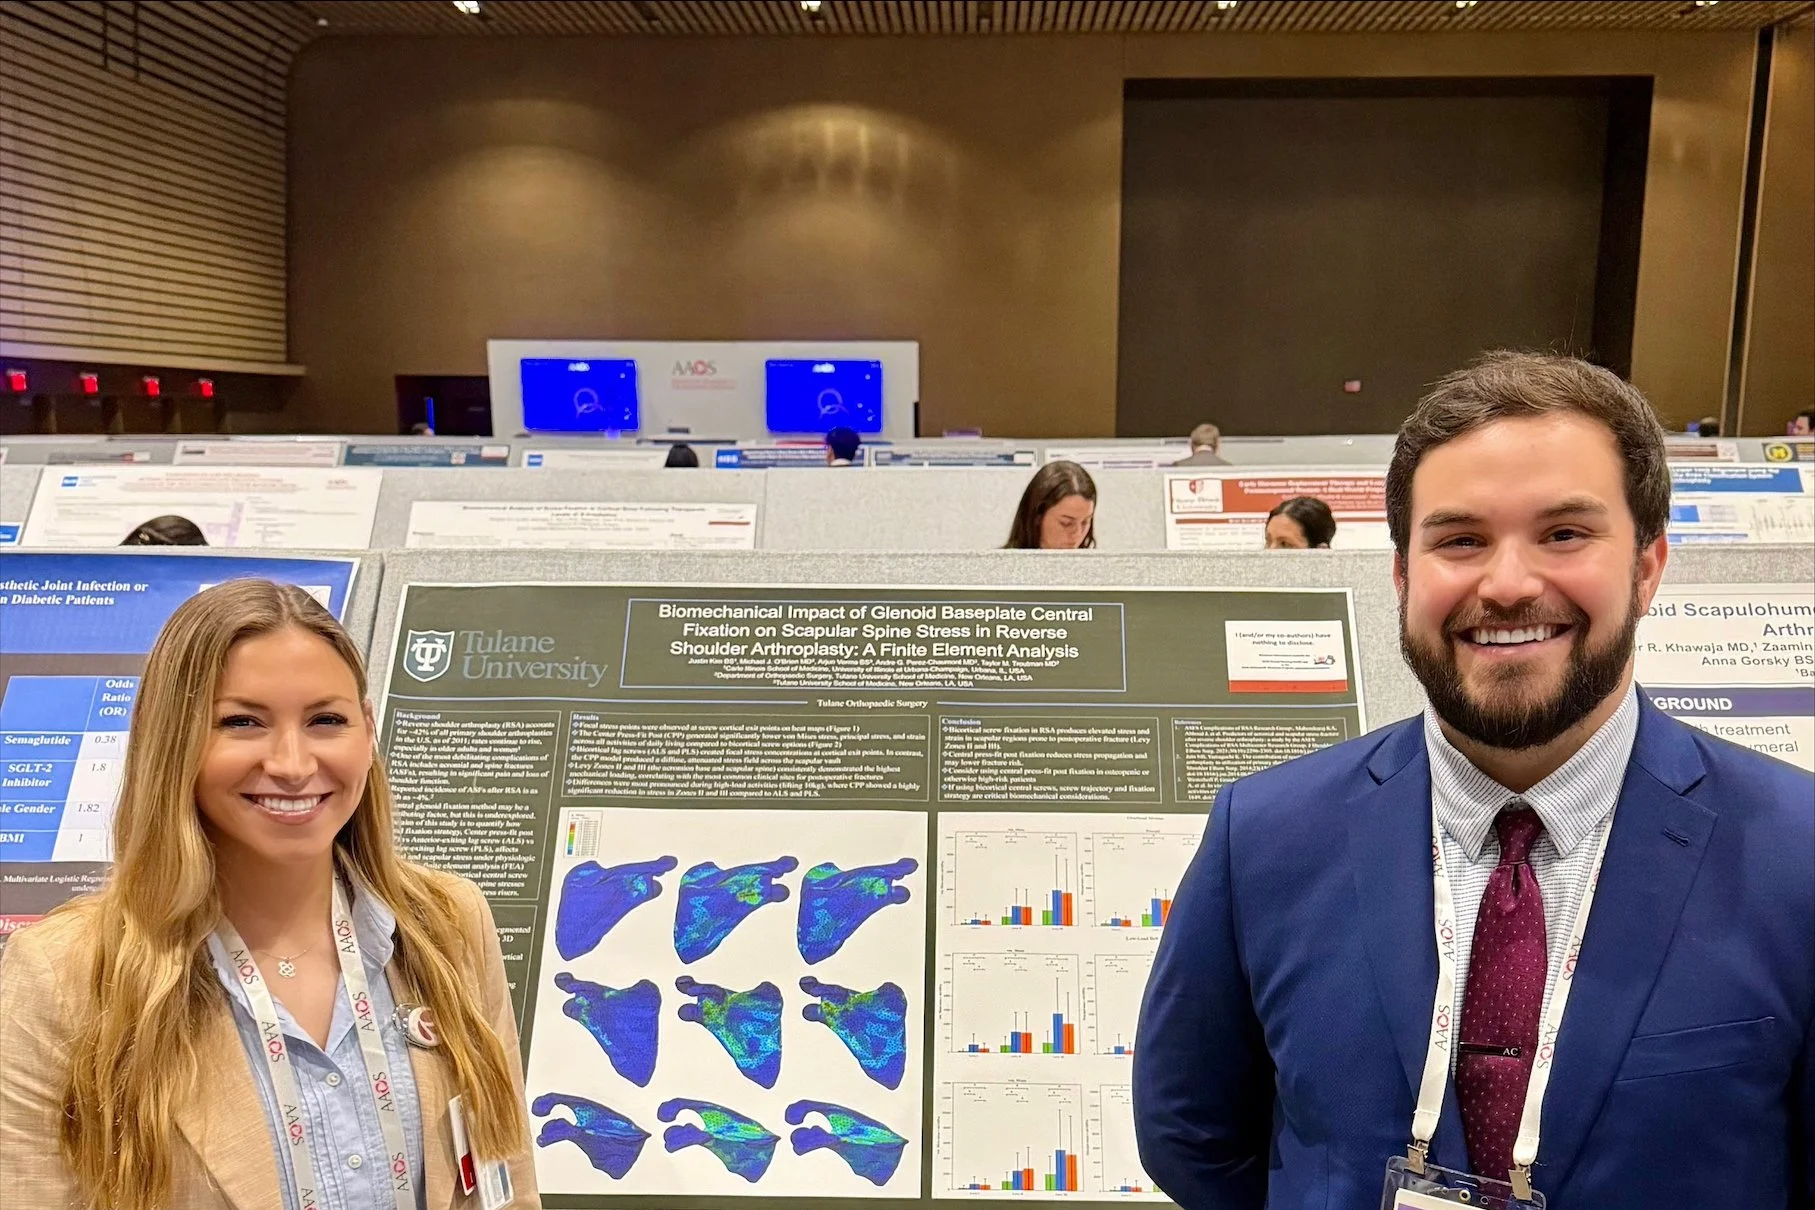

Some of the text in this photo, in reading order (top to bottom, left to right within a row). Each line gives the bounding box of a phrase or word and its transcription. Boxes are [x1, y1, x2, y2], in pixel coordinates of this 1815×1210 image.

[672, 360, 717, 376] AAOS
[41, 580, 73, 591] Joint
[76, 581, 130, 591] Infection
[134, 583, 148, 591] or
[11, 595, 62, 605] Diabetic
[65, 595, 114, 605] Patients
[659, 605, 1092, 622] Biomechanical Impact of Glenoid Baseplate Central
[1684, 603, 1815, 619] Scapulohum
[683, 623, 1067, 640] Fixation on Scapular Spine Stress in Reverse
[459, 629, 555, 655] Tulane
[1647, 643, 1661, 652] R.
[1665, 643, 1723, 654] Khawaja
[1762, 642, 1812, 652] Zaamin
[670, 641, 1079, 660] Shoulder Arthroplasty: A Finite Element Analysis
[1701, 656, 1737, 666] Anna
[1741, 656, 1789, 667] Gorsky
[463, 654, 608, 688] University
[105, 680, 134, 689] Odds
[102, 693, 131, 702] Ratio
[817, 699, 928, 709] Tulane Orthopaedic Surgery
[1650, 697, 1733, 711] GROUND
[99, 707, 127, 717] (OR)
[396, 712, 441, 721] Background
[941, 718, 981, 726] Conclusion
[1714, 723, 1791, 736] treatment
[4, 735, 117, 747] Semaglutide 0.38
[7, 763, 107, 773] SGLT-2 1.8
[2, 778, 52, 788] Inhibitor
[14, 804, 56, 814] Gender
[77, 804, 100, 813] 1.82
[0, 833, 24, 843] BMI
[3, 875, 49, 884] Multivariate
[50, 876, 80, 885] Logistic
[335, 919, 356, 954] AAOS
[1439, 919, 1455, 962] AAOS
[230, 949, 259, 985] AAOS
[352, 990, 375, 1032] AAOS
[1434, 1003, 1450, 1051] AAOS
[262, 1020, 285, 1063] AAOS
[1537, 1023, 1560, 1070] AAOS
[1502, 1047, 1519, 1056] AC
[372, 1071, 395, 1112] AAOS
[284, 1104, 304, 1146] AAOS
[392, 1151, 410, 1192] AAOS
